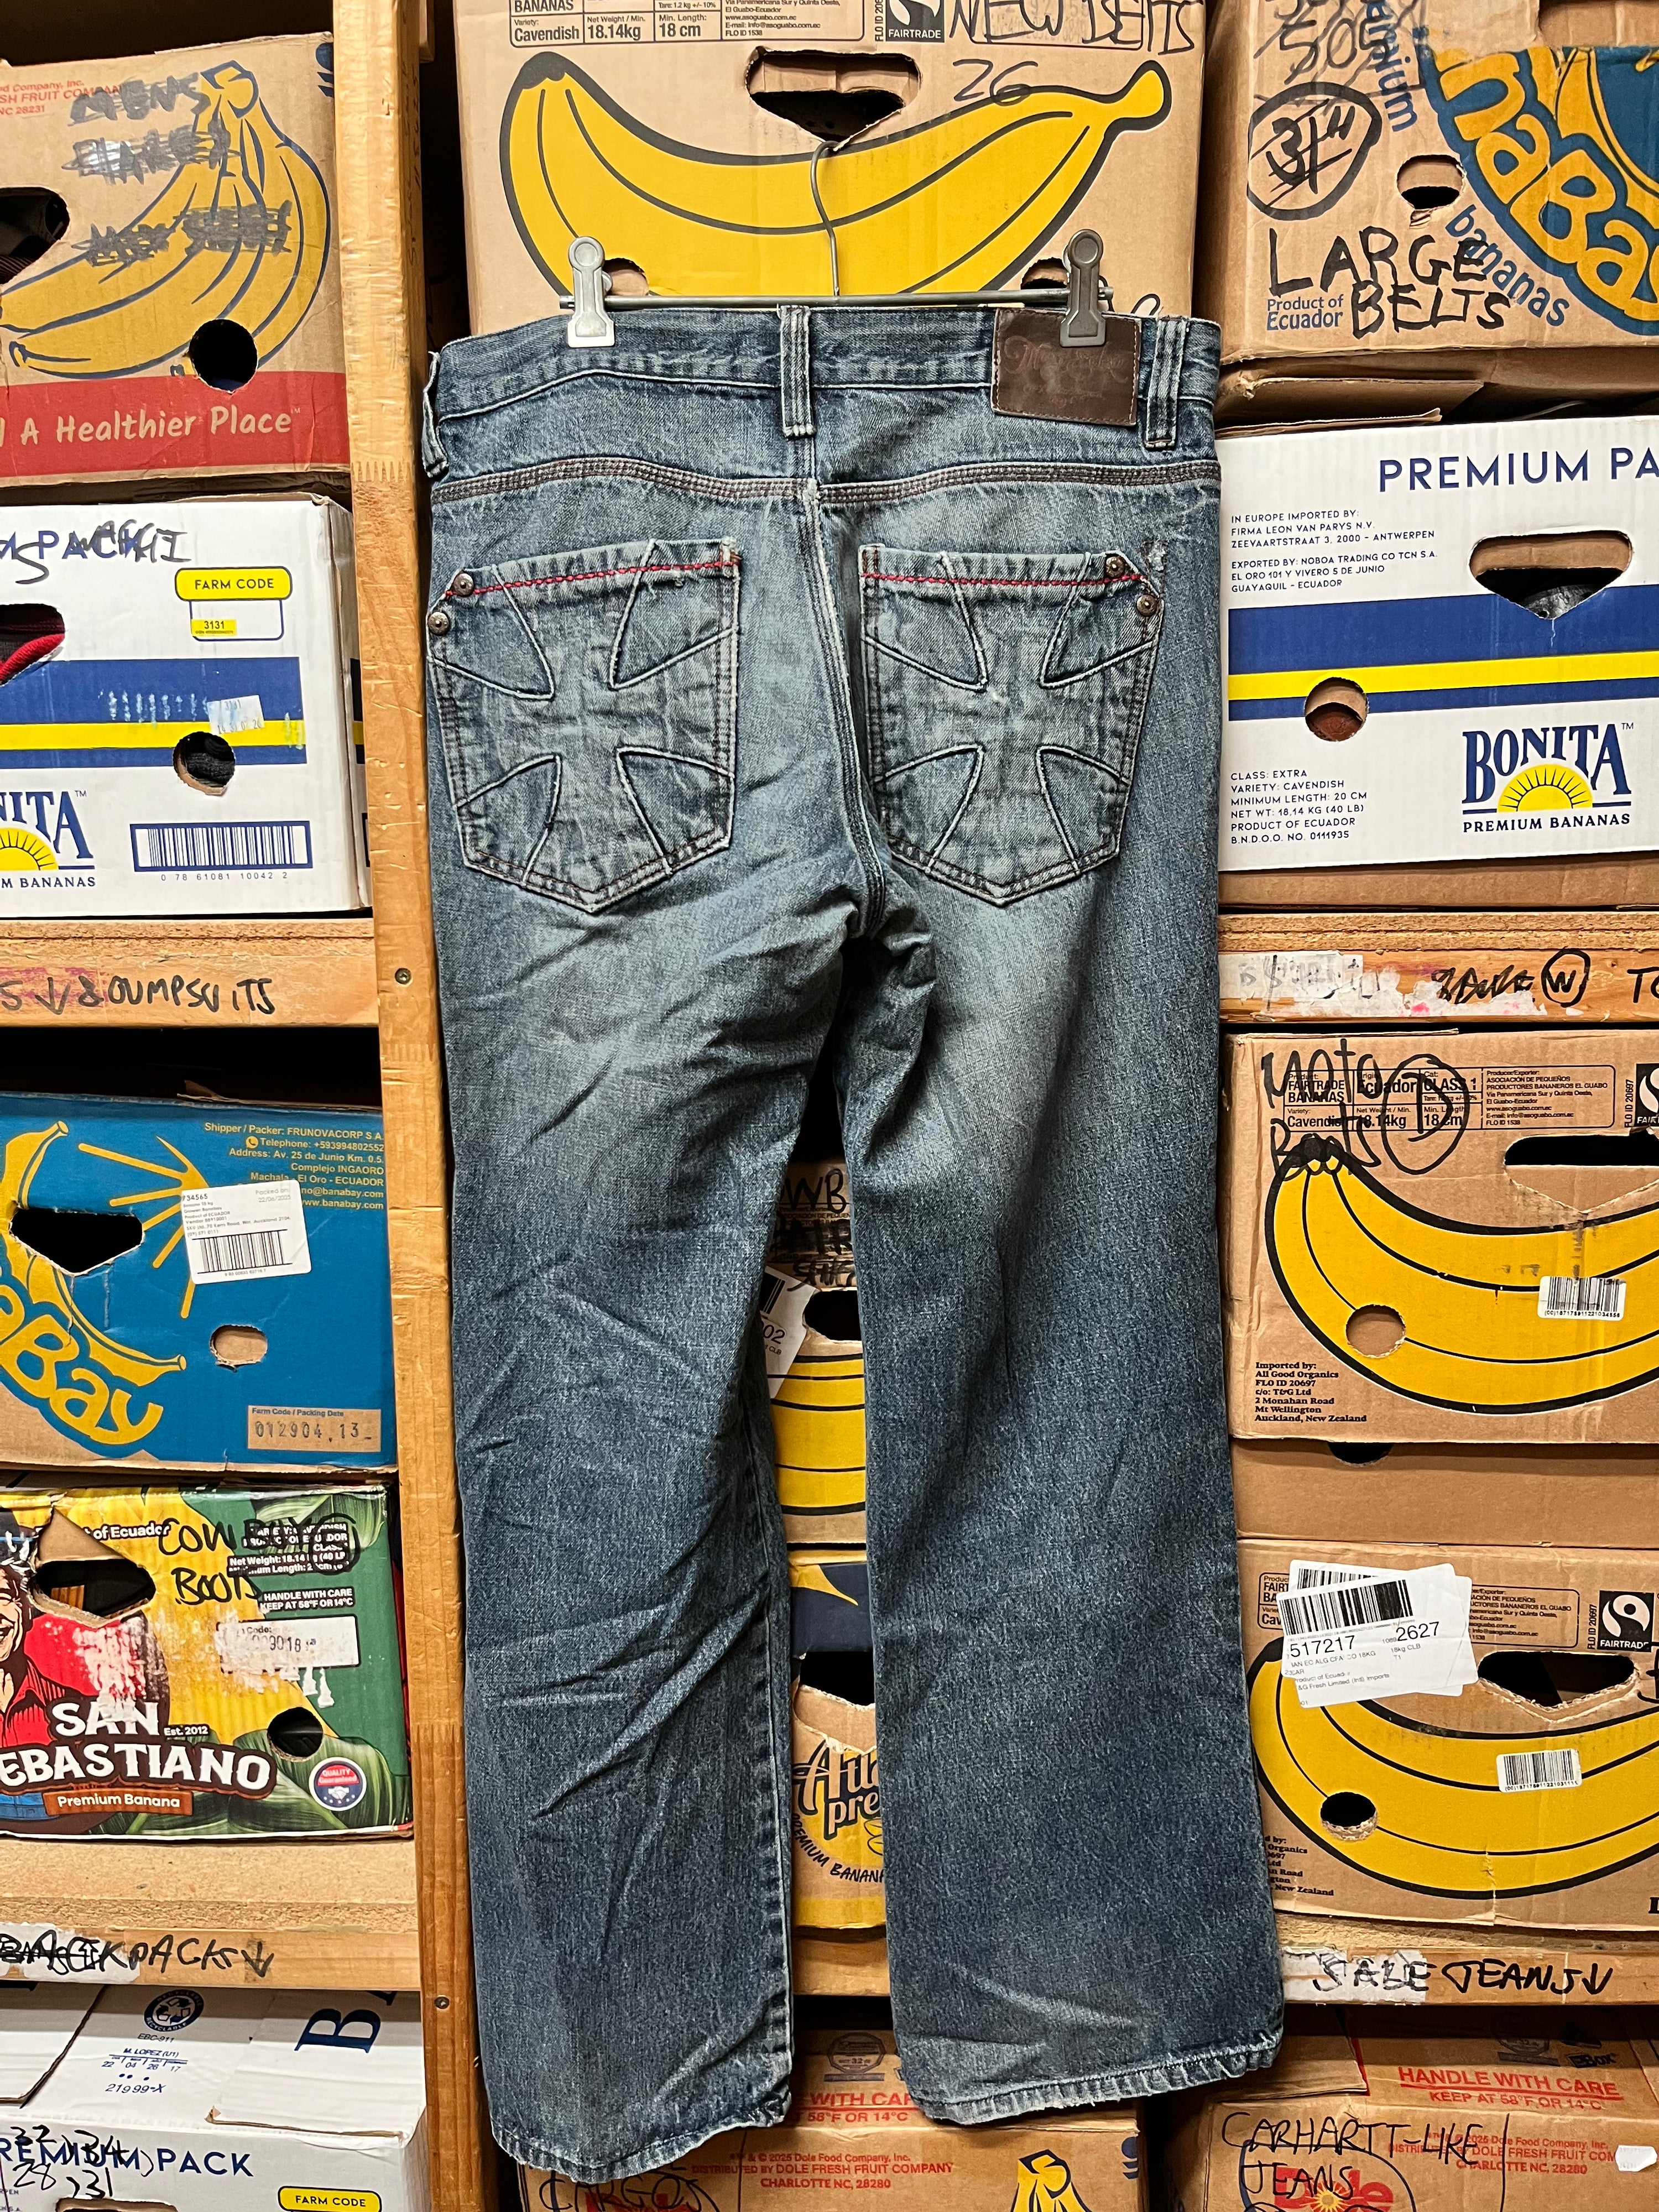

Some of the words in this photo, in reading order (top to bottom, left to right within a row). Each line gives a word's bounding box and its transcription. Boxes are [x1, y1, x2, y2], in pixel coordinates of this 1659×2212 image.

[678, 14, 707, 22] Length:
[514, 26, 580, 41] Cavendish
[588, 24, 641, 41] 18.14kg
[659, 23, 676, 37] 18
[680, 25, 701, 36] cm
[889, 29, 941, 38] FAIRTRADE
[22, 90, 60, 102] FRUIT
[1267, 225, 1489, 297] LARGE
[1267, 296, 1324, 311] Product
[1328, 294, 1343, 308] of
[1352, 283, 1511, 340] BELTS
[1267, 309, 1343, 331] Ecuador
[20, 418, 39, 445] A
[56, 410, 197, 444] Healthier
[210, 405, 292, 435] Place
[1380, 448, 1589, 492] PREMIUM
[1245, 513, 1284, 523] EUROPE
[1288, 510, 1339, 520] IMPORTED
[1231, 528, 1261, 536] FIRMA
[1266, 525, 1292, 534] LEON
[1320, 522, 1352, 531] PARYS
[1232, 536, 1320, 549] ZEEVAARTSTRAAT
[1337, 535, 1360, 543] 2000
[1373, 531, 1434, 541] ANTWERPEN
[1232, 559, 1279, 569] EXPORTED
[1301, 556, 1334, 565] NOBOA
[1338, 554, 1378, 563] TRADING
[1295, 568, 1329, 577] VIVERO
[1356, 565, 1384, 573] JUNIO
[195, 579, 231, 590] FARM
[237, 578, 274, 589] CODE
[1232, 583, 1286, 592] GUAYAQUIL
[1298, 580, 1342, 589] ECUADOR
[204, 620, 225, 630] 3131
[1462, 724, 1631, 804] BONITA
[1273, 770, 1307, 778] EXTRA
[1284, 780, 1344, 790] CAVENDISH
[1231, 796, 1281, 806] MINIMUM
[1231, 810, 1251, 818] NET
[1231, 821, 1282, 831] PRODUCT
[1286, 820, 1300, 828] OF
[1305, 817, 1355, 828] ECUADOR
[1464, 818, 1542, 833] PREMIUM
[1550, 813, 1630, 828] BANANAS
[1311, 831, 1349, 840] 0111935
[20, 877, 96, 888] BANANAS
[241, 872, 273, 880] 10042
[205, 1123, 241, 1133] Shipper
[288, 1128, 363, 1139] FRUNOVACORP
[261, 1138, 311, 1148] Telephone:
[314, 1141, 384, 1152] +593994802552
[229, 1148, 270, 1158] Address:
[305, 1152, 316, 1160] de
[319, 1153, 345, 1162] Junio
[291, 1163, 335, 1173] Complejo
[338, 1165, 384, 1175] INGAORO
[310, 1175, 327, 1183] Oro
[336, 1176, 384, 1186] ECUADOR
[1256, 1362, 1300, 1370] Imported
[1302, 1362, 1317, 1370] by:
[1254, 1415, 1303, 1423] Auckland,
[93, 1527, 108, 1540] of
[110, 1522, 171, 1539] Ecuador
[248, 1556, 281, 1566] Weight:
[273, 1563, 306, 1574] Length:
[264, 1592, 302, 1601] HANDLE
[302, 1590, 326, 1599] WITH
[327, 1588, 352, 1597] CARE
[259, 1602, 284, 1611] KEEP
[285, 1601, 298, 1609] AT
[319, 1599, 333, 1608] OR
[1396, 1621, 1439, 1641] 2627
[1290, 1635, 1355, 1658] 517217
[52, 1702, 161, 1738] SAN
[184, 1725, 208, 1736] 2012
[56, 1793, 122, 1808] Premium
[124, 1794, 180, 1808] Banana
[1280, 1869, 1303, 1877] Road
[1297, 1886, 1334, 1896] Zealand
[138, 2033, 175, 2043] EBC-911
[1398, 2067, 1491, 2086] HANDLE
[1493, 2073, 1552, 2090] WITH
[1557, 2078, 1620, 2096] CARE
[811, 2093, 864, 2106] WITH
[1430, 2091, 1472, 2103] KEEP
[1478, 2093, 1496, 2104] AT
[1538, 2096, 1562, 2109] OR
[846, 2112, 868, 2122] OR
[1222, 2111, 1484, 2167] CARHARTT-LIKE
[1516, 2137, 1540, 2147] Food
[818, 2153, 842, 2162] Food
[1509, 2148, 1547, 2159] FRESH
[1551, 2150, 1585, 2161] FRUIT
[156, 2148, 253, 2177] PACK
[776, 2164, 809, 2174] DOLE
[811, 2164, 850, 2174] FRESH
[854, 2163, 888, 2173] FRUIT
[892, 2162, 954, 2173] COMPANY
[760, 2178, 831, 2189] CHARLOTTE
[1241, 2161, 1355, 2198] JEANS
[295, 2195, 328, 2206] FARM
[330, 2195, 367, 2208] CODE
